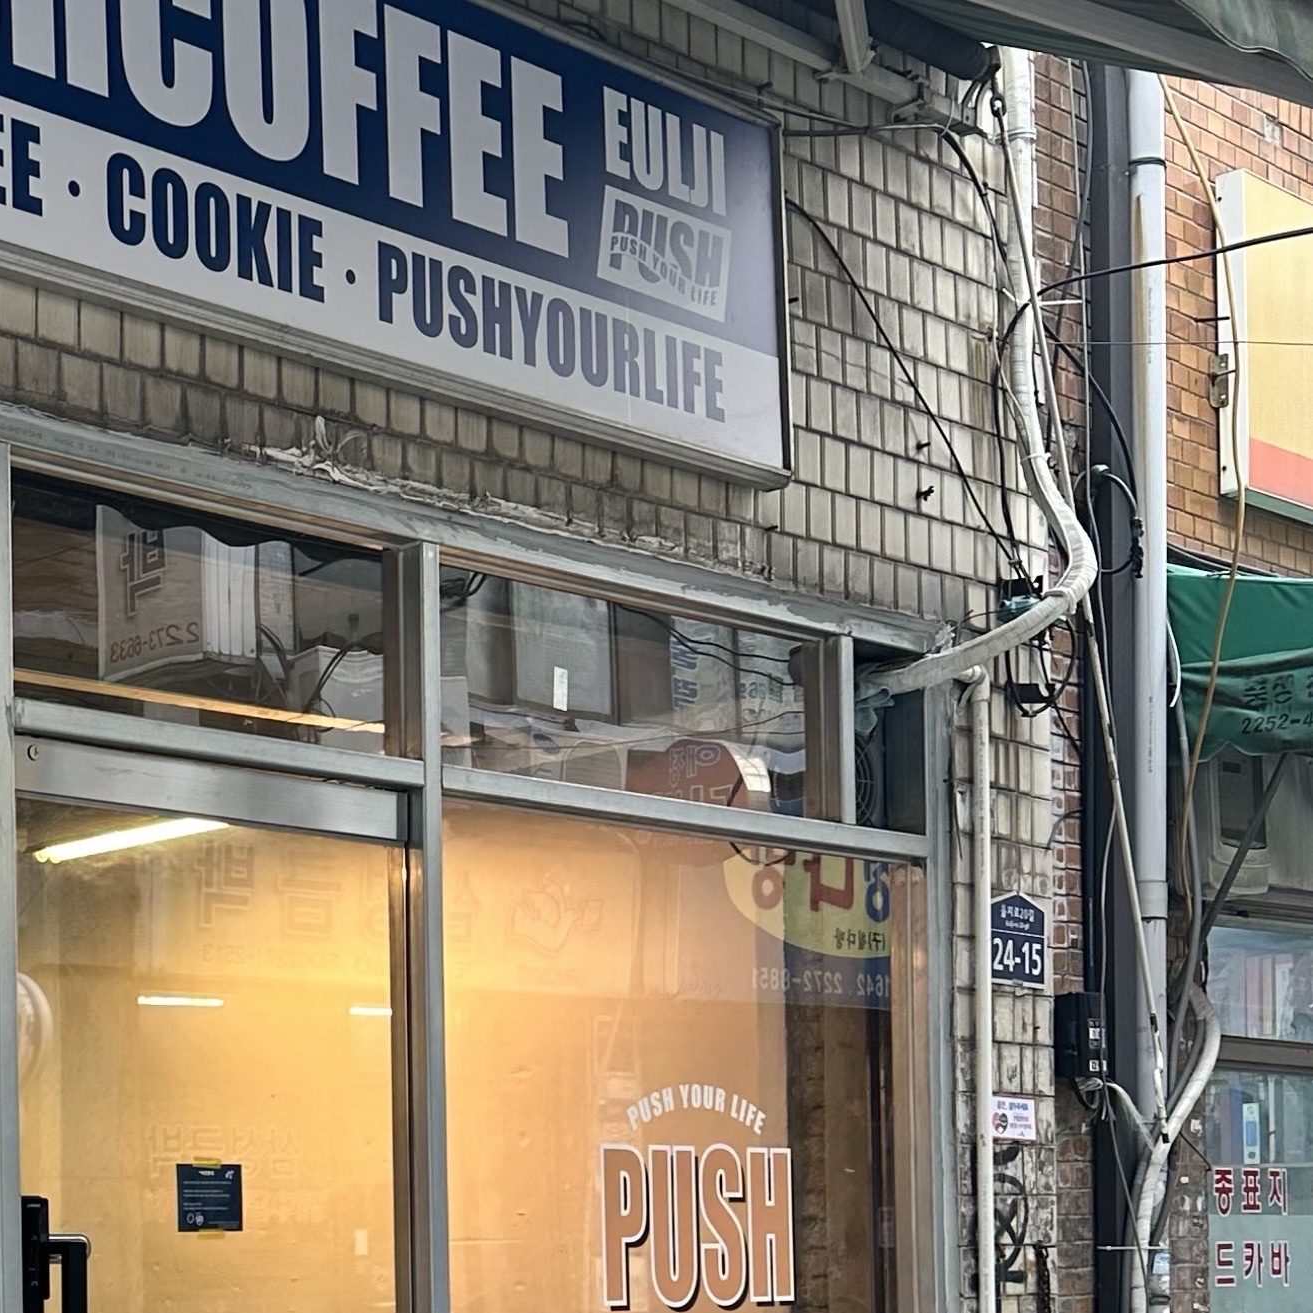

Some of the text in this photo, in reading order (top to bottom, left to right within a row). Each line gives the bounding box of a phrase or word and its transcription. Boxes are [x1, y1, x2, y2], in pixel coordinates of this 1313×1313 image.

[602, 85, 728, 218] EULJI
[106, 152, 326, 304] COOKIE
[377, 240, 727, 424] PUSHYOURLIFE
[608, 198, 725, 289] PUSH
[609, 235, 718, 307] PUSH YOUR LIFE
[992, 937, 1043, 976] 24-15
[627, 1083, 767, 1135] PUSH YOUR LIFE
[600, 1142, 796, 1311] PUSH
